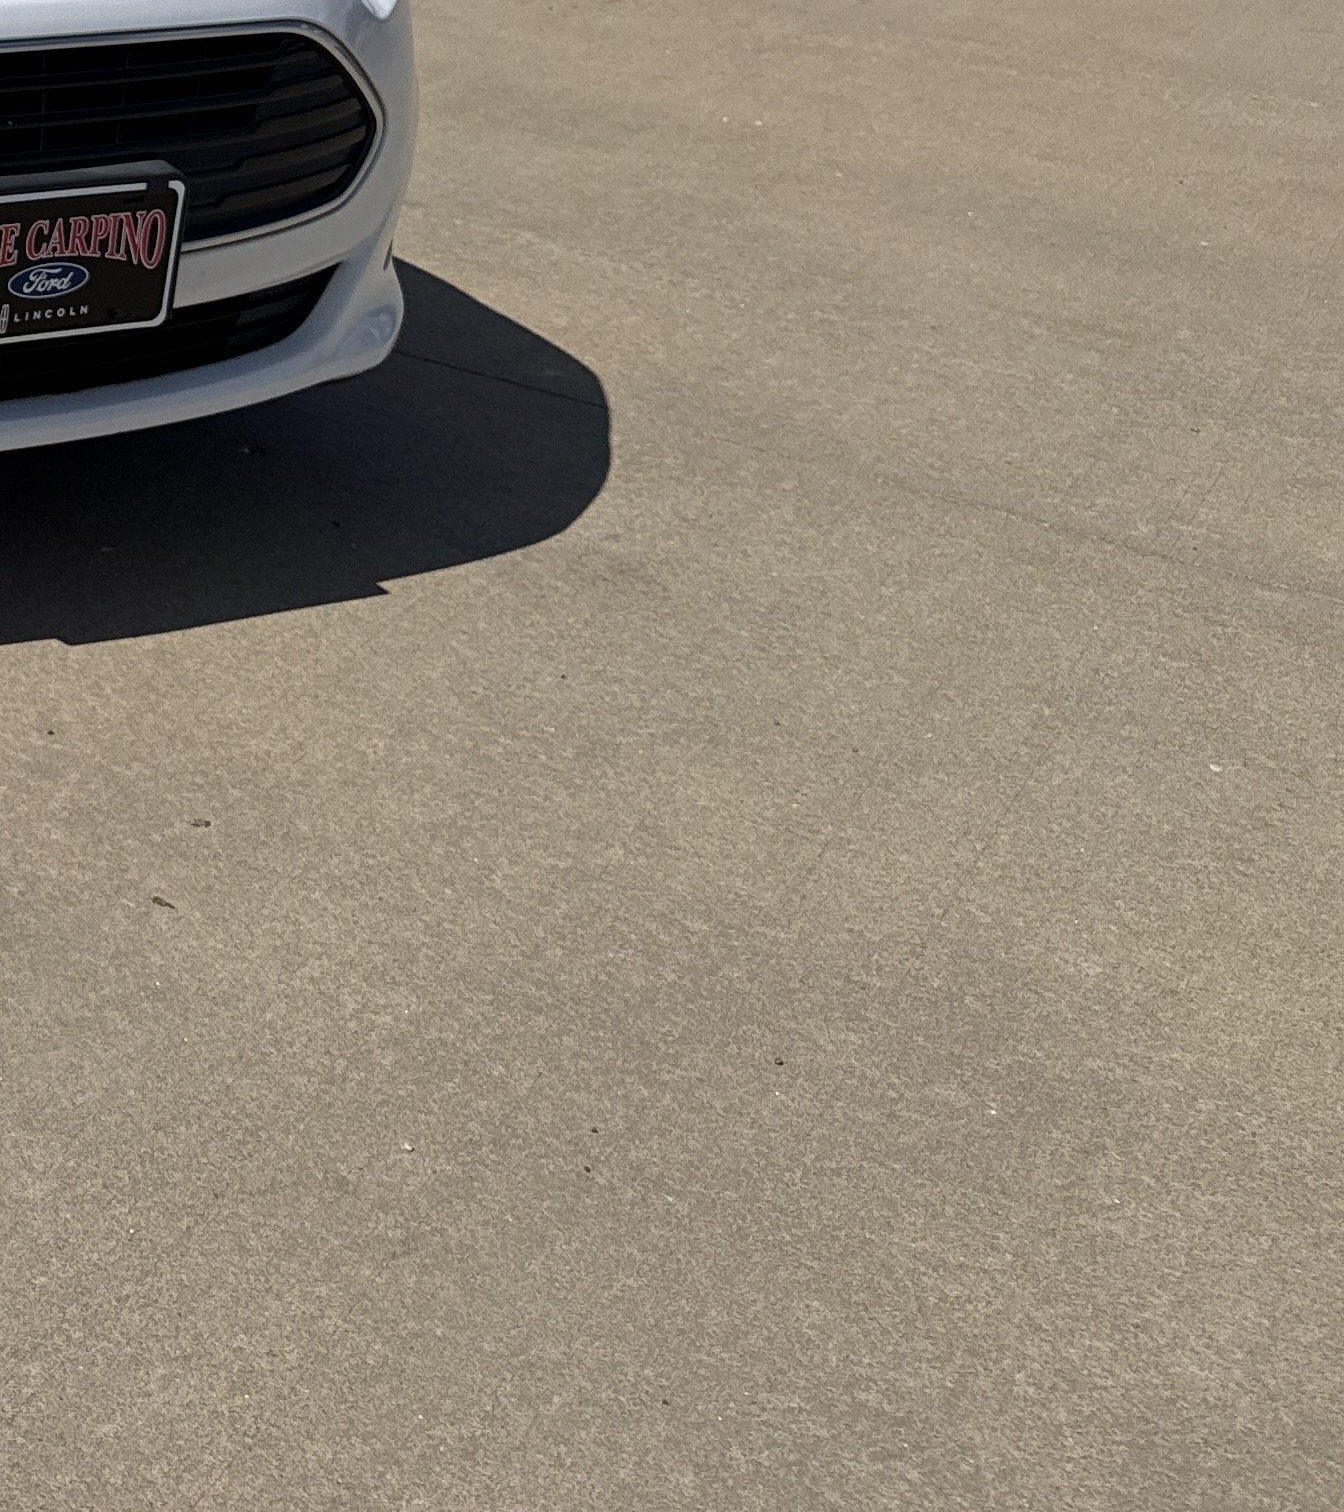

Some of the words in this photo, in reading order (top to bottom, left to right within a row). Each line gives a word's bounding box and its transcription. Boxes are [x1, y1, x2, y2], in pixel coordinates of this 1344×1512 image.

[25, 208, 167, 269] CARPINO
[22, 267, 72, 292] Ford
[13, 304, 89, 322] LINCOLN
